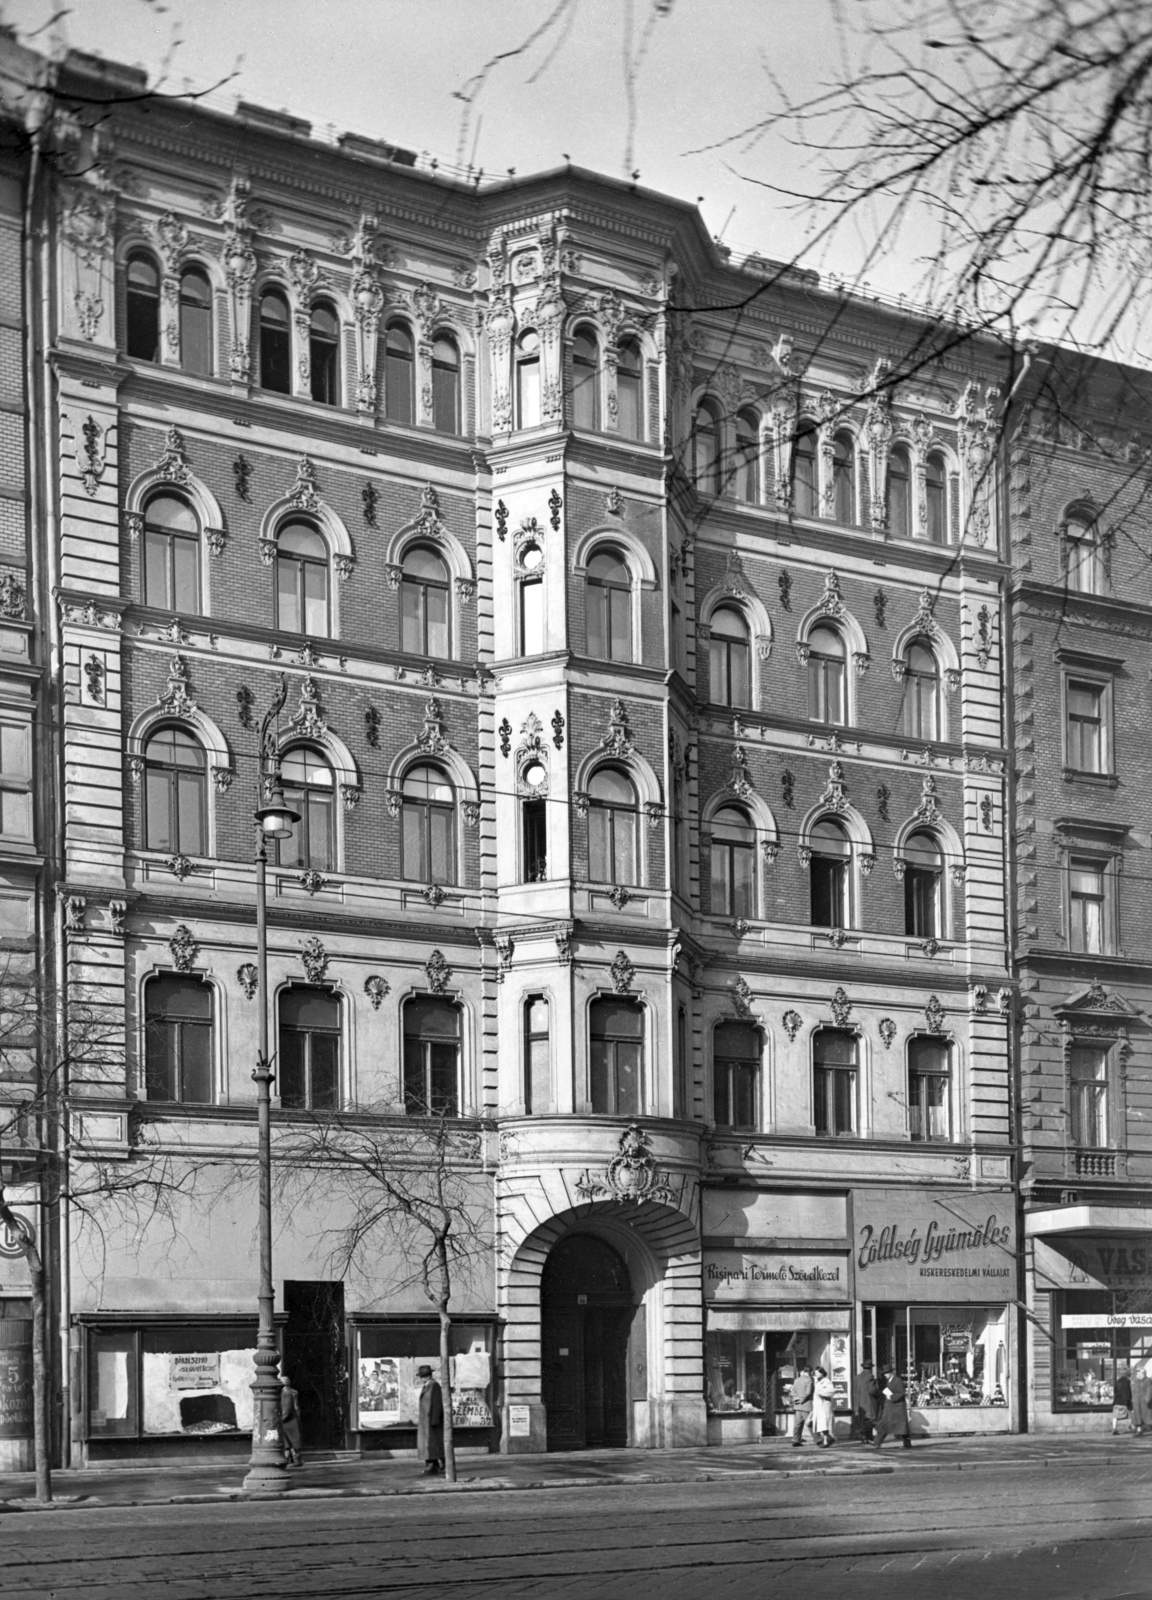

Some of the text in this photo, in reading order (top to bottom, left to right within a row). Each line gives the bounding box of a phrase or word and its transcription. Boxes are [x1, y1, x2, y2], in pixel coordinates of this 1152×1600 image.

[858, 1224, 921, 1271] Zöldség
[704, 1263, 840, 1286] Kisipari Termelő Szövetkezet
[919, 1264, 1010, 1278] KISKERESKEDELMI VÁLLALAT
[8, 1366, 19, 1384] 5
